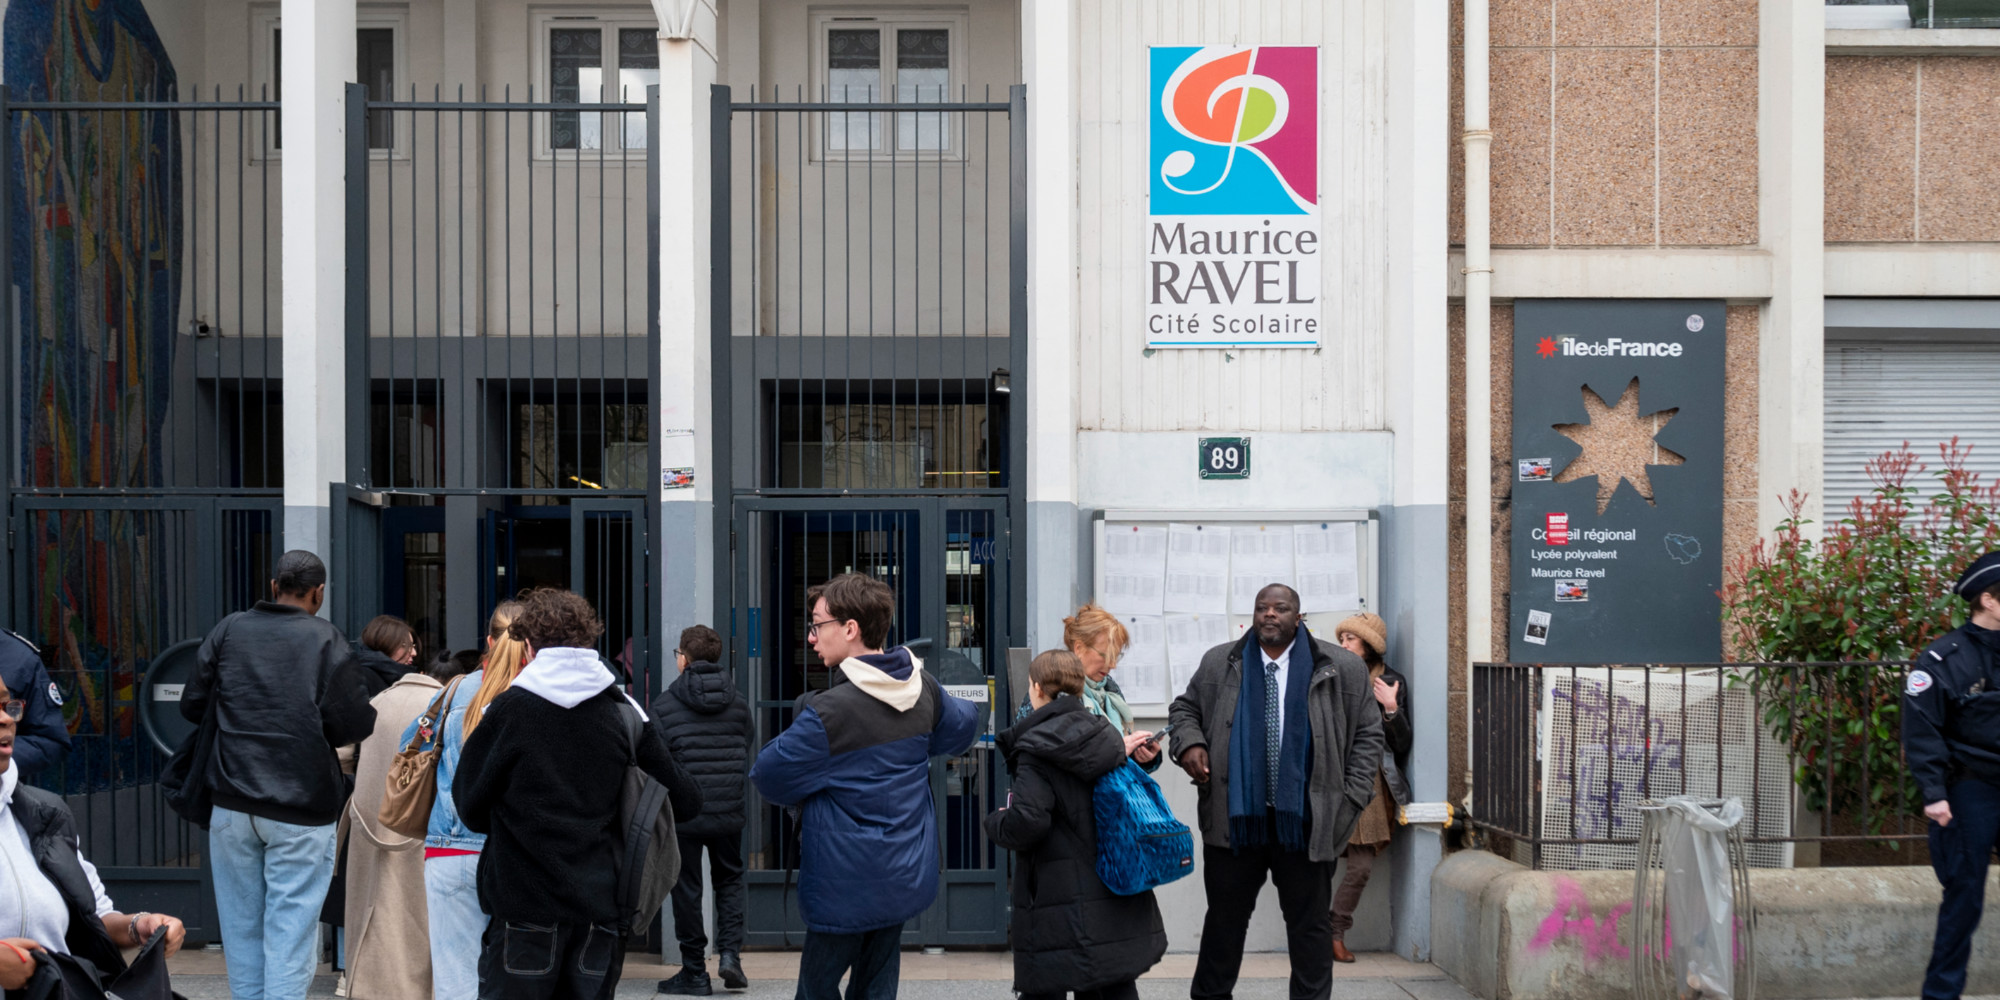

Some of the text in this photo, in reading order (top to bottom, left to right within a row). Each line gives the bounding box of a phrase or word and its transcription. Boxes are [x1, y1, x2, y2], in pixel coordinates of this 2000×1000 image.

[1150, 220, 1318, 255] Maurice
[1150, 260, 1316, 305] RAVEL
[1149, 313, 1318, 334] Cité Scolaire
[1211, 447, 1239, 470] 89
[1531, 527, 1580, 541] Coeil
[1583, 528, 1636, 544] régional
[1531, 548, 1618, 561] Lycée polyvalent
[1531, 567, 1606, 578] Maurice Ravel
